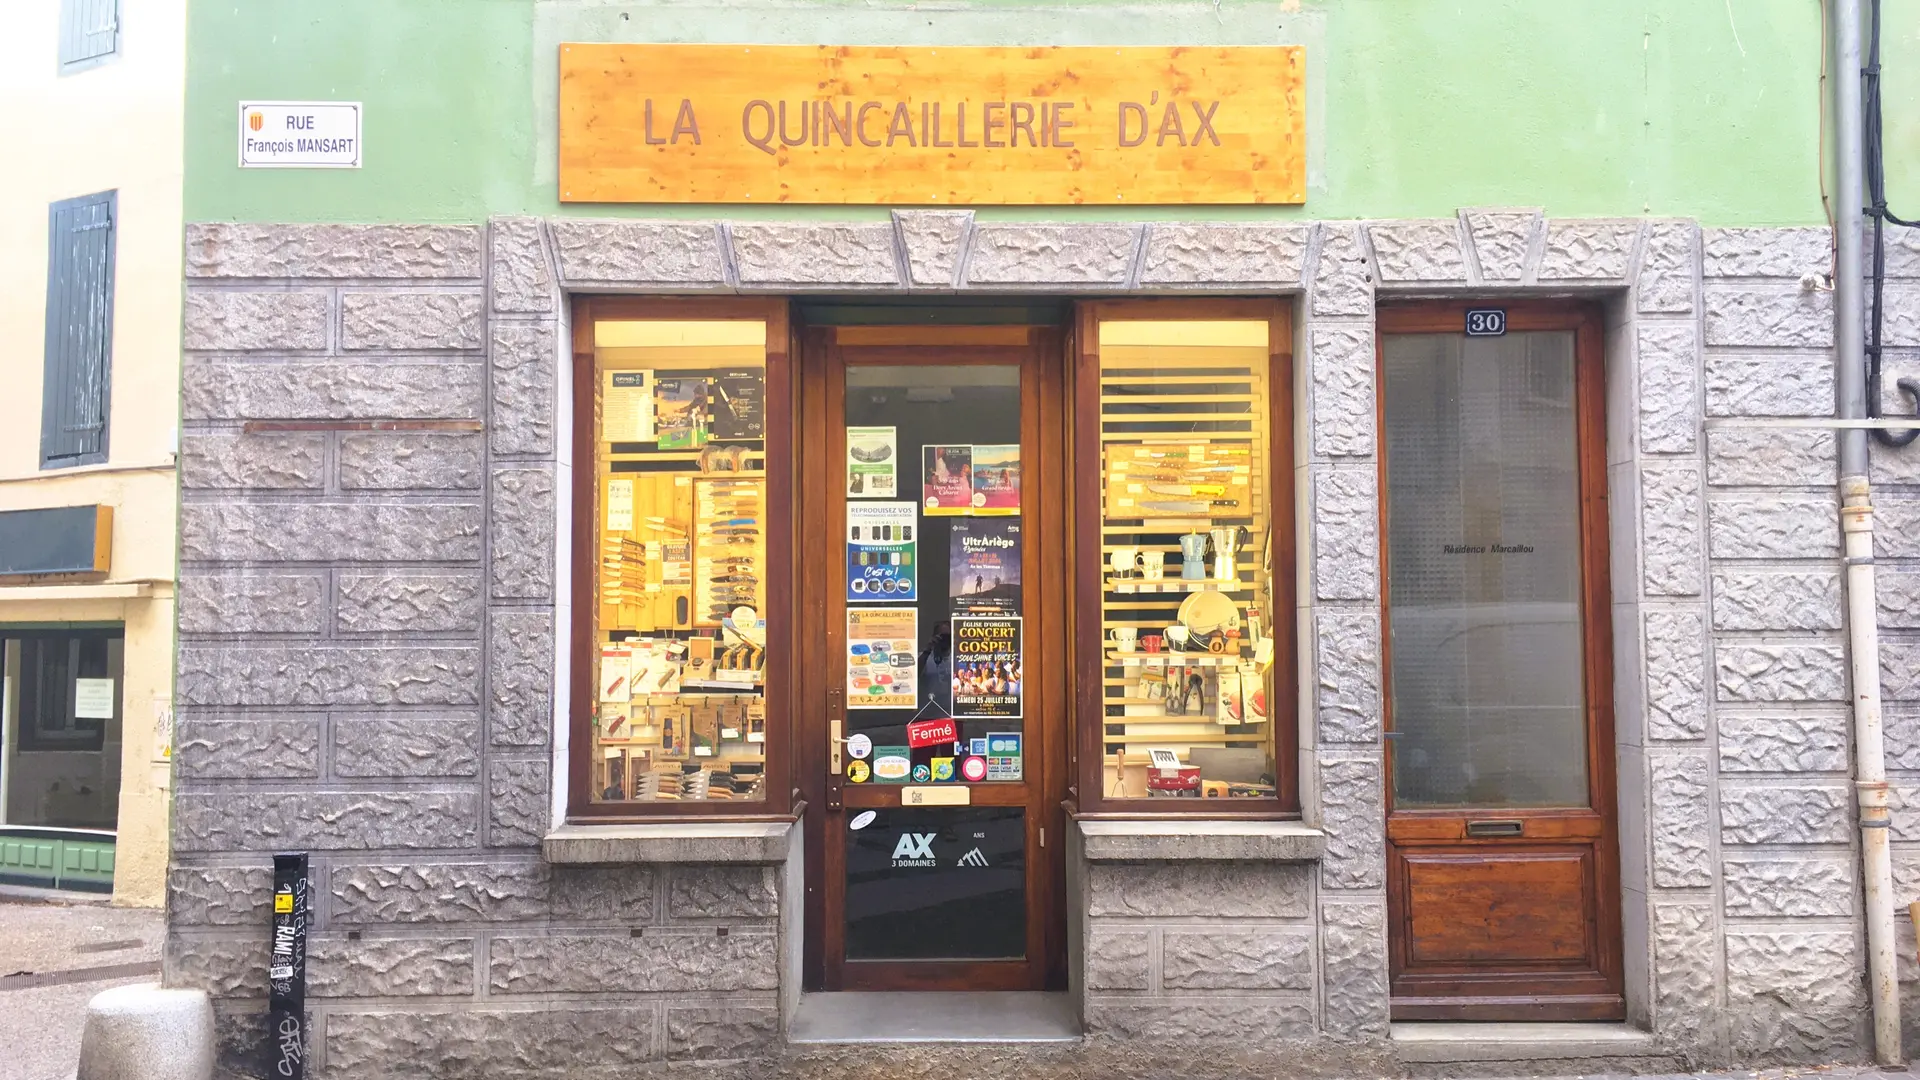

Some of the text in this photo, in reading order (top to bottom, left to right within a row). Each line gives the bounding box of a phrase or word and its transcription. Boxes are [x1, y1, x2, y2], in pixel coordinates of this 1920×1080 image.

[286, 115, 315, 130] RUE
[644, 90, 1221, 156] LA QUINCAILLERIE D'AX
[247, 138, 354, 156] François MANSART
[1471, 313, 1501, 332] 30
[1443, 544, 1535, 554] Résidence Marcaillou
[959, 627, 1016, 638] CONCERT
[959, 641, 1016, 653] GOSPEL
[956, 696, 977, 704] SAMEDI
[985, 696, 1004, 704] JUILLET
[911, 723, 953, 741] Fermé
[891, 832, 937, 859] AX
[273, 925, 296, 956] RAMI
